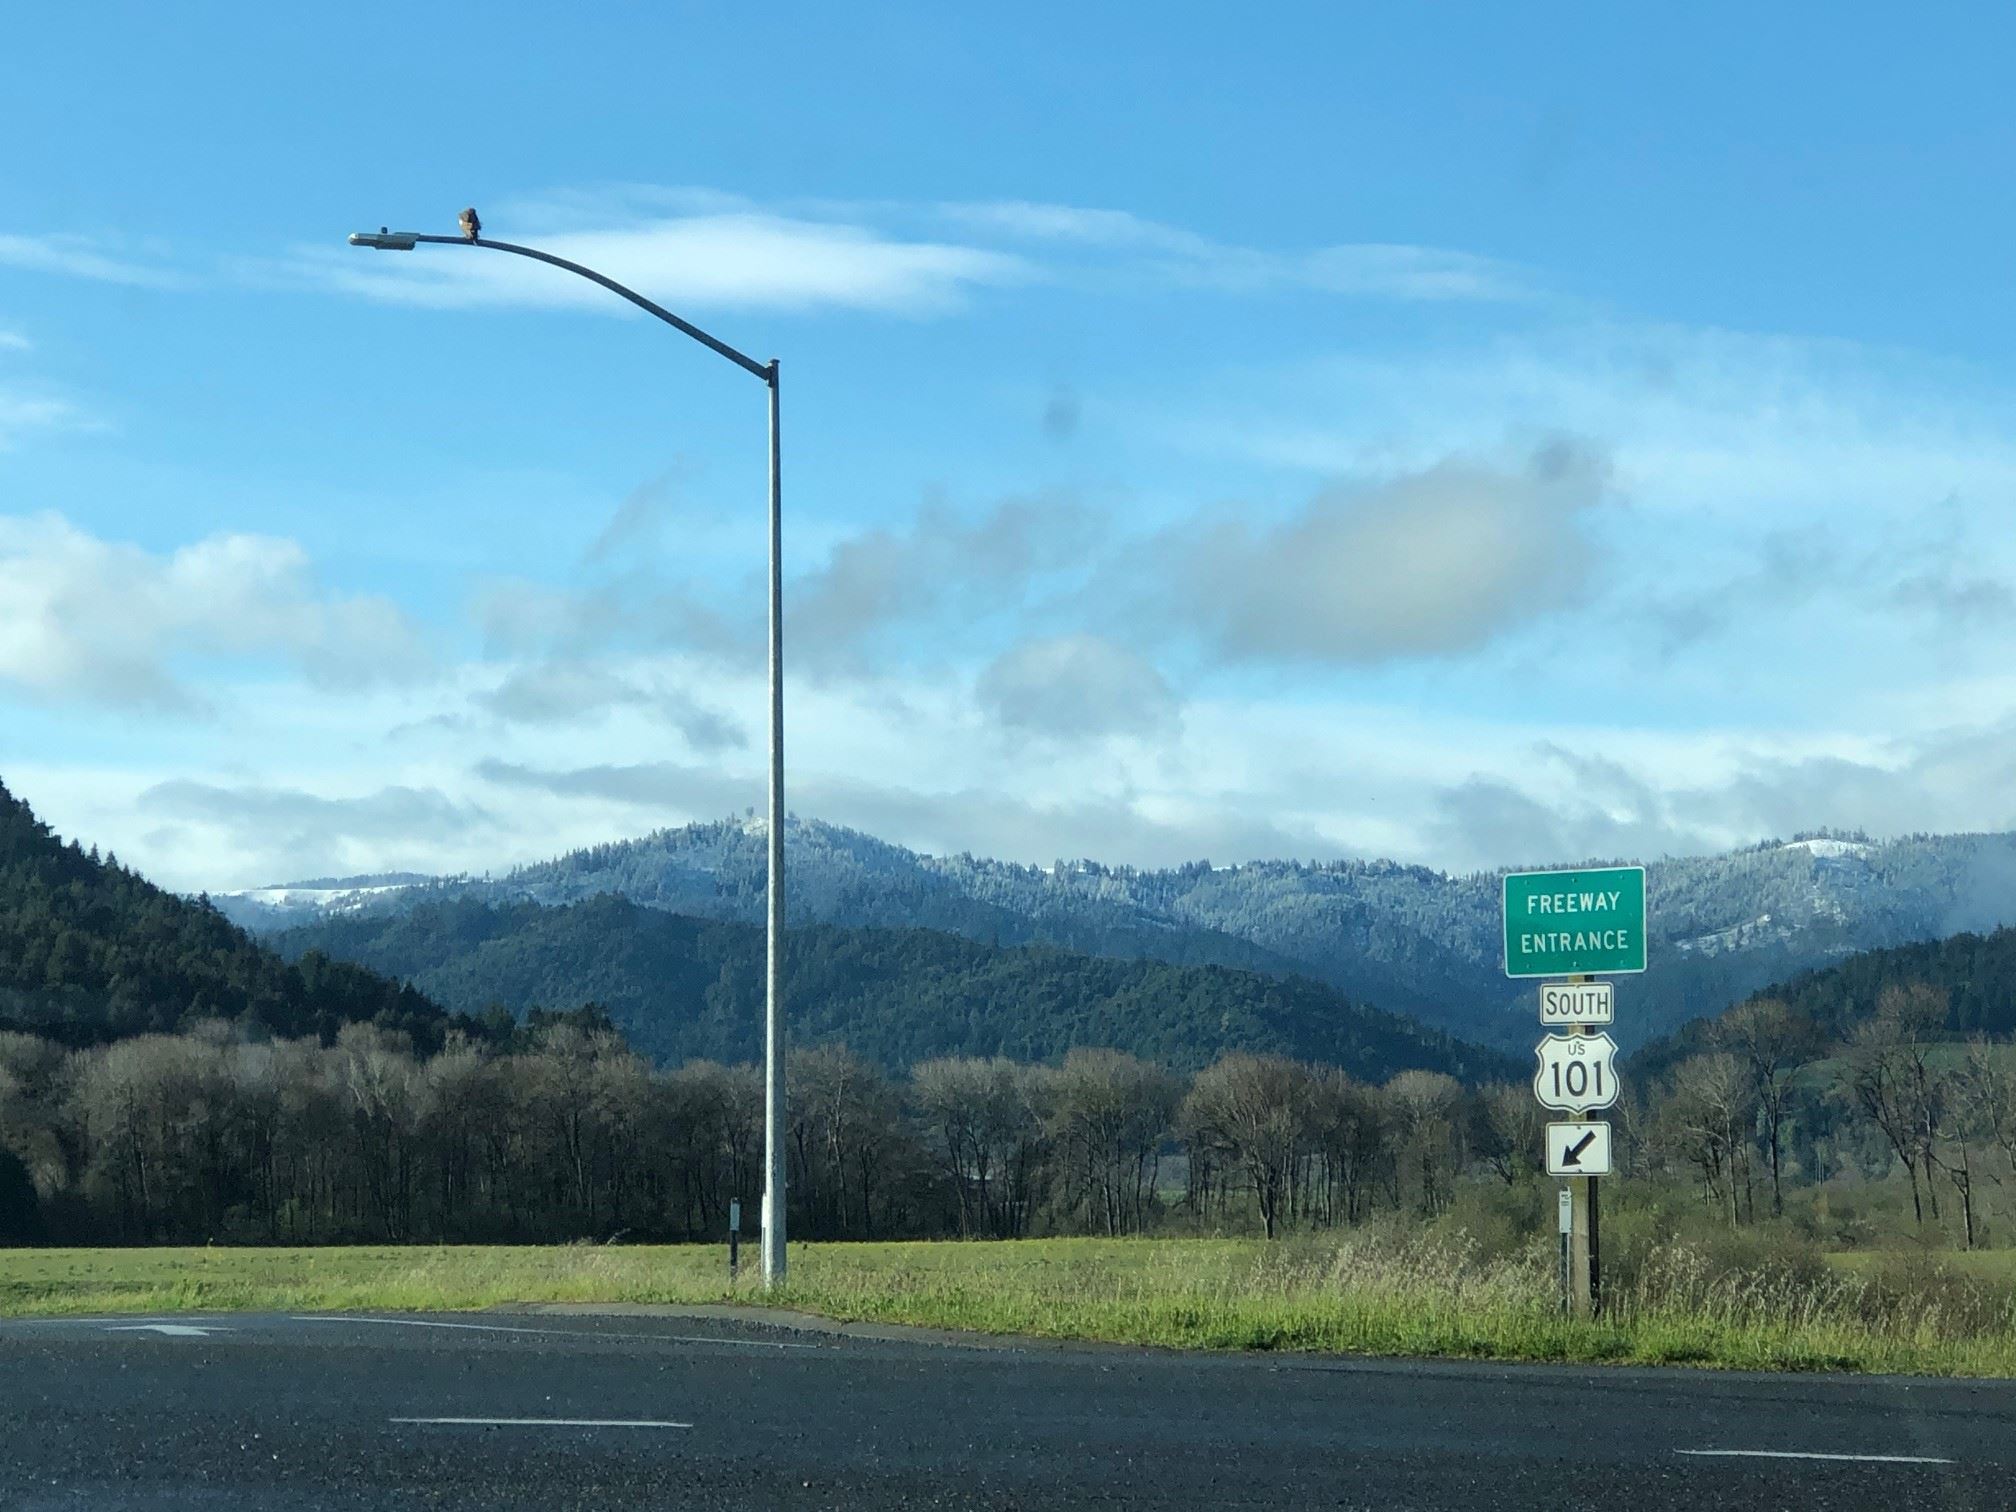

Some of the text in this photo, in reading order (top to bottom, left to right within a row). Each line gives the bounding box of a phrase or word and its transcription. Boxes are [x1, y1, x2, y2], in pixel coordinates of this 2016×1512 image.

[1527, 891, 1621, 914] FREEWAY
[1521, 930, 1629, 954] ENTRANCE
[1545, 991, 1609, 1016] SOUTH
[1567, 1043, 1586, 1056] US
[1551, 1060, 1604, 1098] 101
